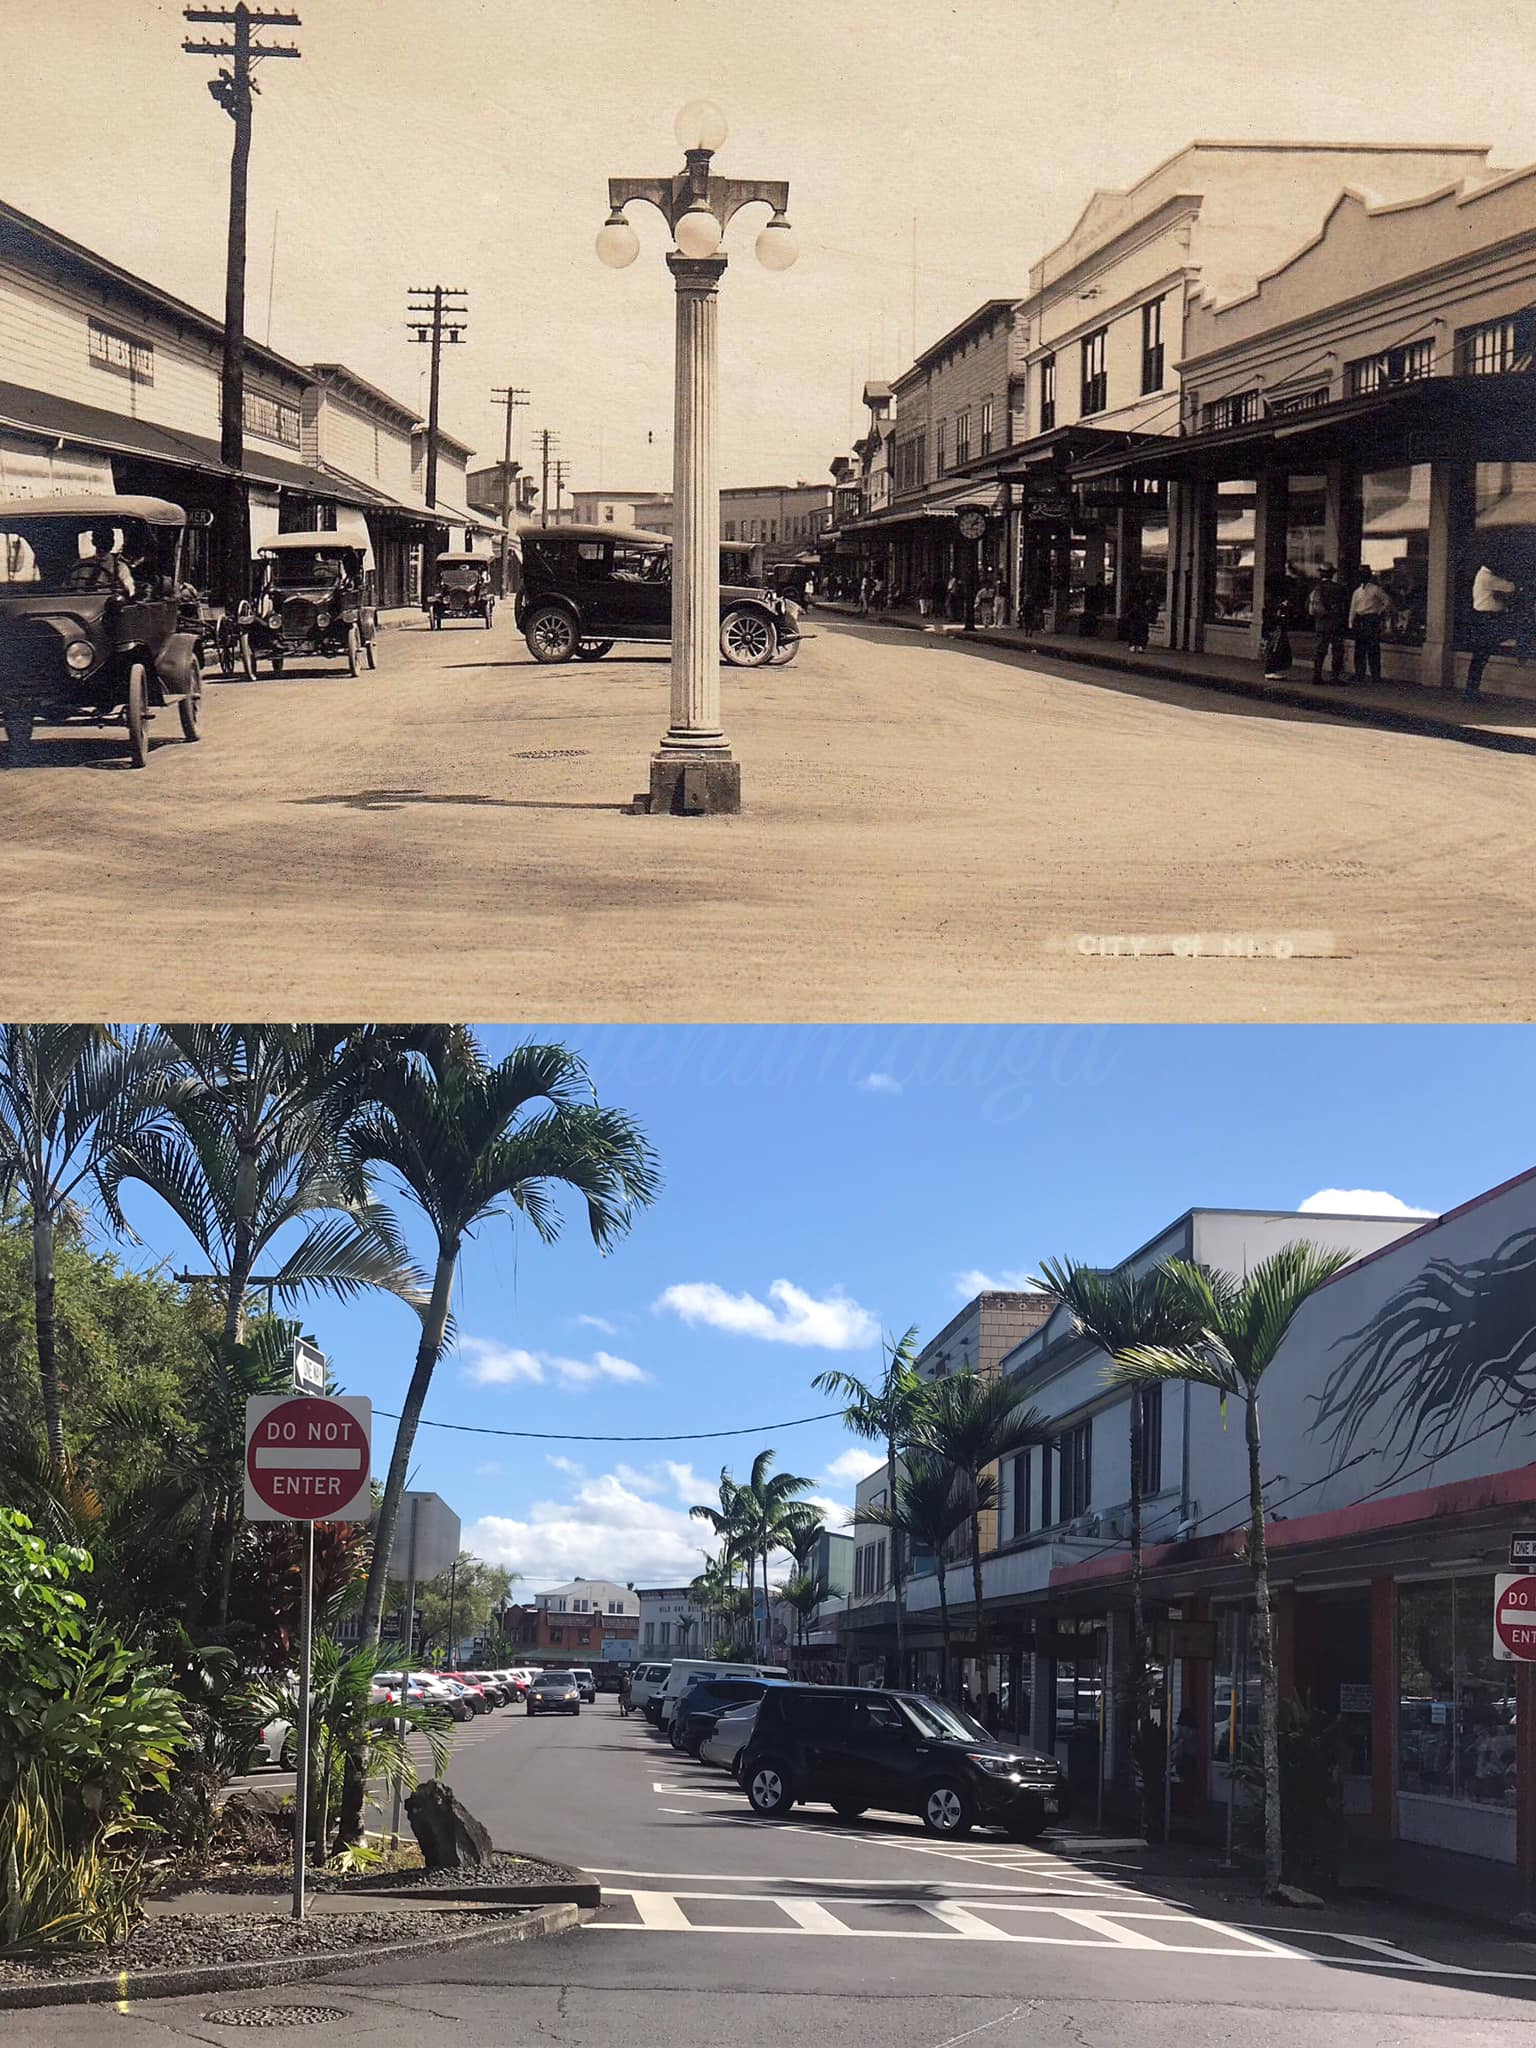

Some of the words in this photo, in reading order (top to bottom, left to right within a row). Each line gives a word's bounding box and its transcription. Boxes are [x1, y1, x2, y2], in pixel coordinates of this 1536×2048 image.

[267, 1422, 296, 1441] DO
[308, 1422, 353, 1441] NOT
[272, 1476, 341, 1496] ENTER
[1514, 1542, 1531, 1556] ONE
[1508, 1591, 1529, 1606] DO
